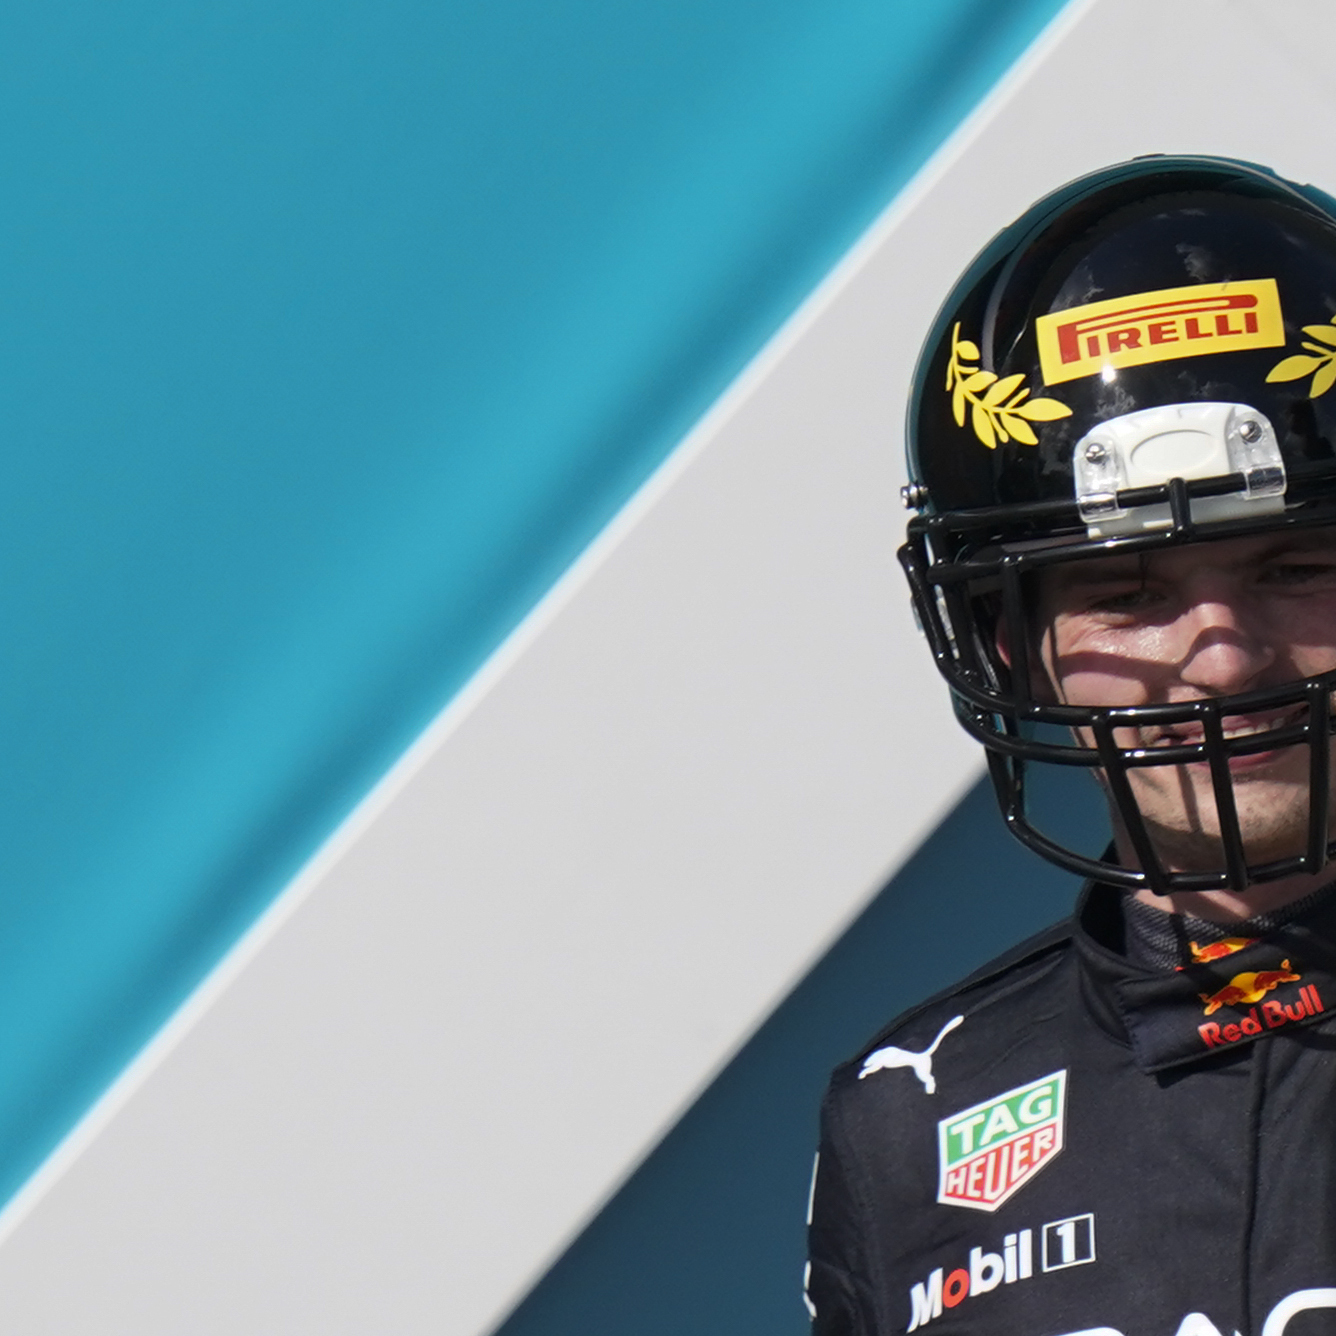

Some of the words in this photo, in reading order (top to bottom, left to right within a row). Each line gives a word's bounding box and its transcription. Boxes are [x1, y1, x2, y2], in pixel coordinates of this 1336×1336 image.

[1056, 293, 1259, 365] PIRELLI
[1197, 1006, 1263, 1049] Red
[1262, 984, 1325, 1029] Bull
[948, 1082, 1054, 1157] TAG
[945, 1126, 1055, 1200] HEUER
[907, 1228, 1032, 1333] Mobil
